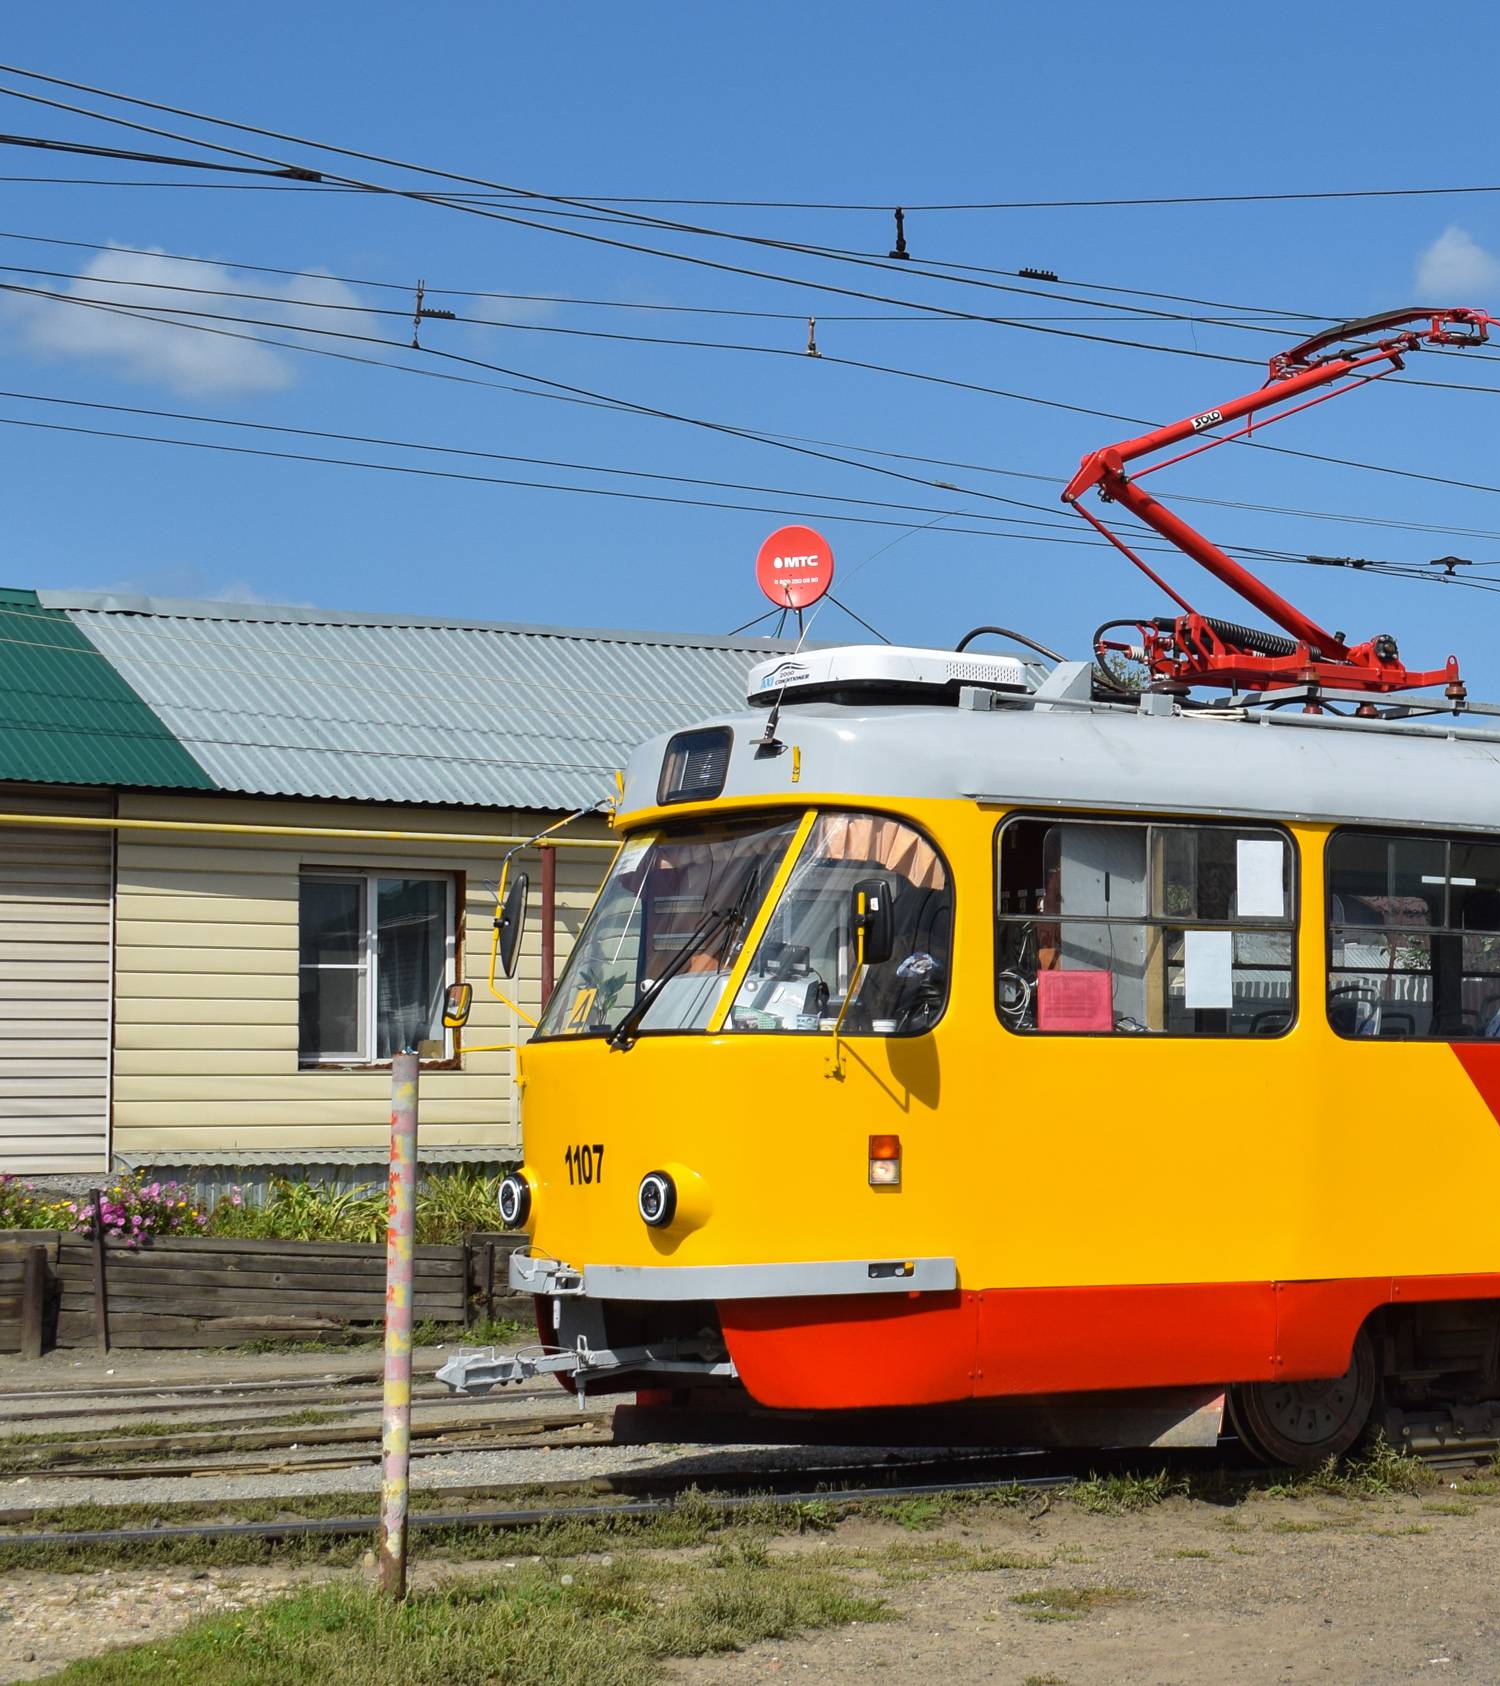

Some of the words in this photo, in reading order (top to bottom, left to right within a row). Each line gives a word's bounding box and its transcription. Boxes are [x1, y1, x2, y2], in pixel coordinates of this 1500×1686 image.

[1195, 411, 1220, 428] SOLO
[784, 555, 819, 568] МТС
[568, 993, 592, 1033] 4
[565, 1144, 604, 1185] 1107
